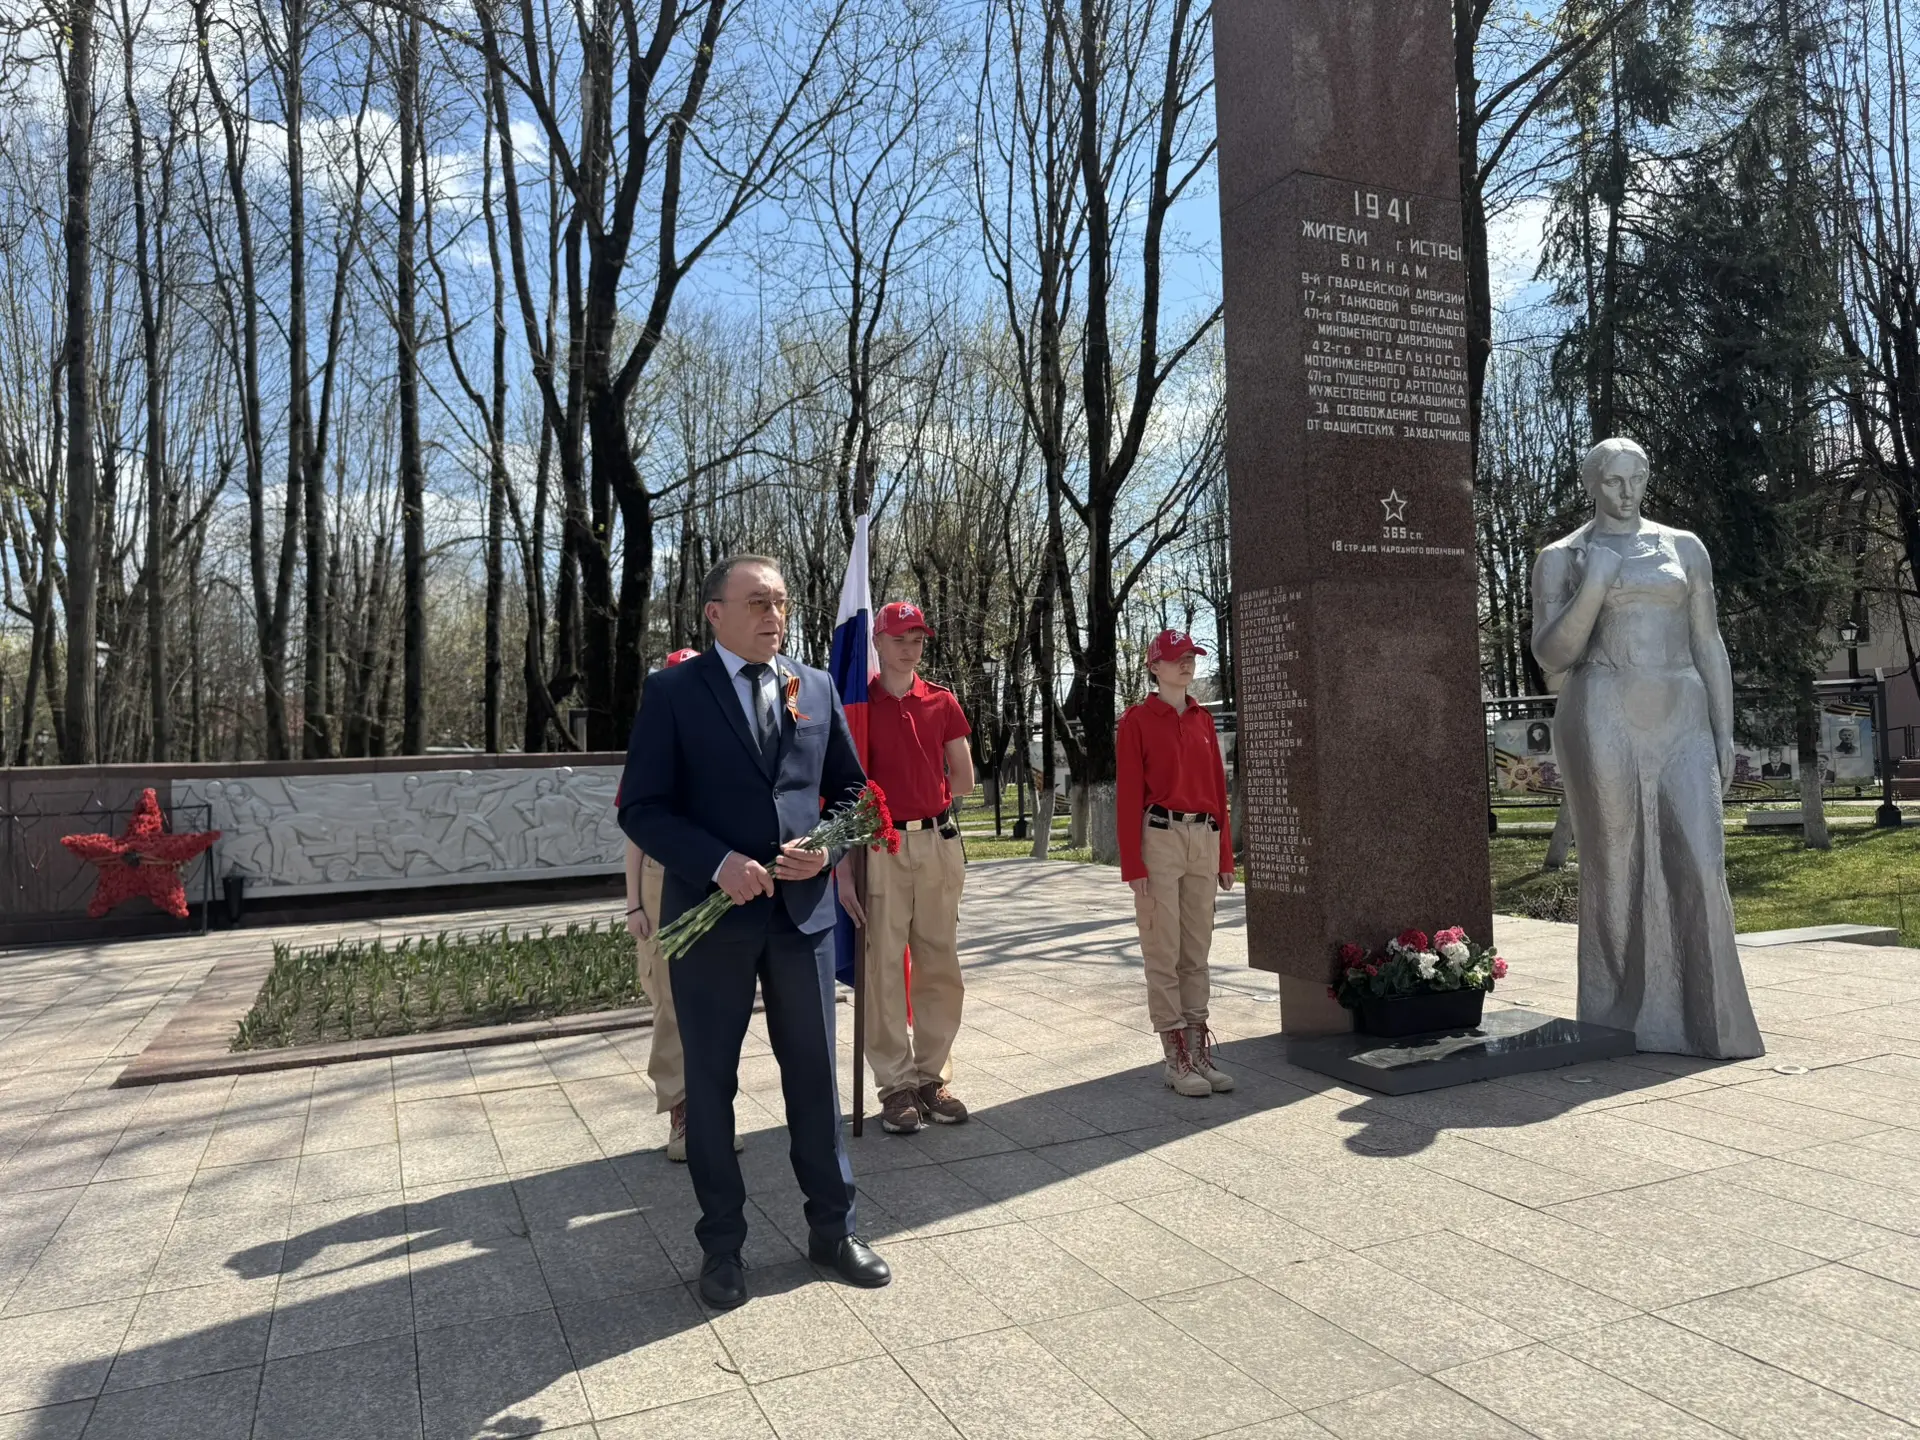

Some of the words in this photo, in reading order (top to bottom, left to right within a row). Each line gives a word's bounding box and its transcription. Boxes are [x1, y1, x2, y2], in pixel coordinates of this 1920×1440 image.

[1355, 190, 1410, 224] 1941
[1302, 220, 1368, 246] ЖИТЕЛИ
[1410, 238, 1462, 261] ИСТРЫ
[1328, 276, 1410, 298] ГВАРДЕЙСКОЙ
[1416, 288, 1465, 305] ДИВИЗИИ
[1304, 290, 1330, 304] 17-й
[1340, 294, 1398, 312] ТАНКОВОЙ
[1410, 304, 1464, 321] БРИГАДЫ
[1318, 324, 1391, 343] МИНОМЕТНОГО
[1397, 333, 1454, 350] ДИВИЗИОНА
[1336, 311, 1406, 330] ГВАРДЕЙСКОГО
[1410, 320, 1465, 338] ОТДЕЛЬНОГО
[1305, 354, 1405, 375] МОТОИНЖЕНЕРНОГО
[1413, 366, 1468, 382] БАТАЛЬОНА
[1309, 384, 1385, 402] МУЖЕСТВЕННО
[1390, 392, 1466, 409] СРАЖАВШИМСЯ
[1336, 373, 1400, 389] ПУШЕЧНОГО
[1406, 380, 1464, 396] АРТПОЛКА
[1316, 402, 1329, 414] ЗА
[1337, 404, 1418, 422] ОСВОБОЖДЕНИЕ
[1425, 412, 1461, 425] ГОРОДА
[1307, 419, 1319, 430] ОТ
[1323, 422, 1394, 436] ФАШИСТСКИХ
[1404, 427, 1470, 442] ЗАХВАТЧИКОВ
[1383, 526, 1407, 539] 365
